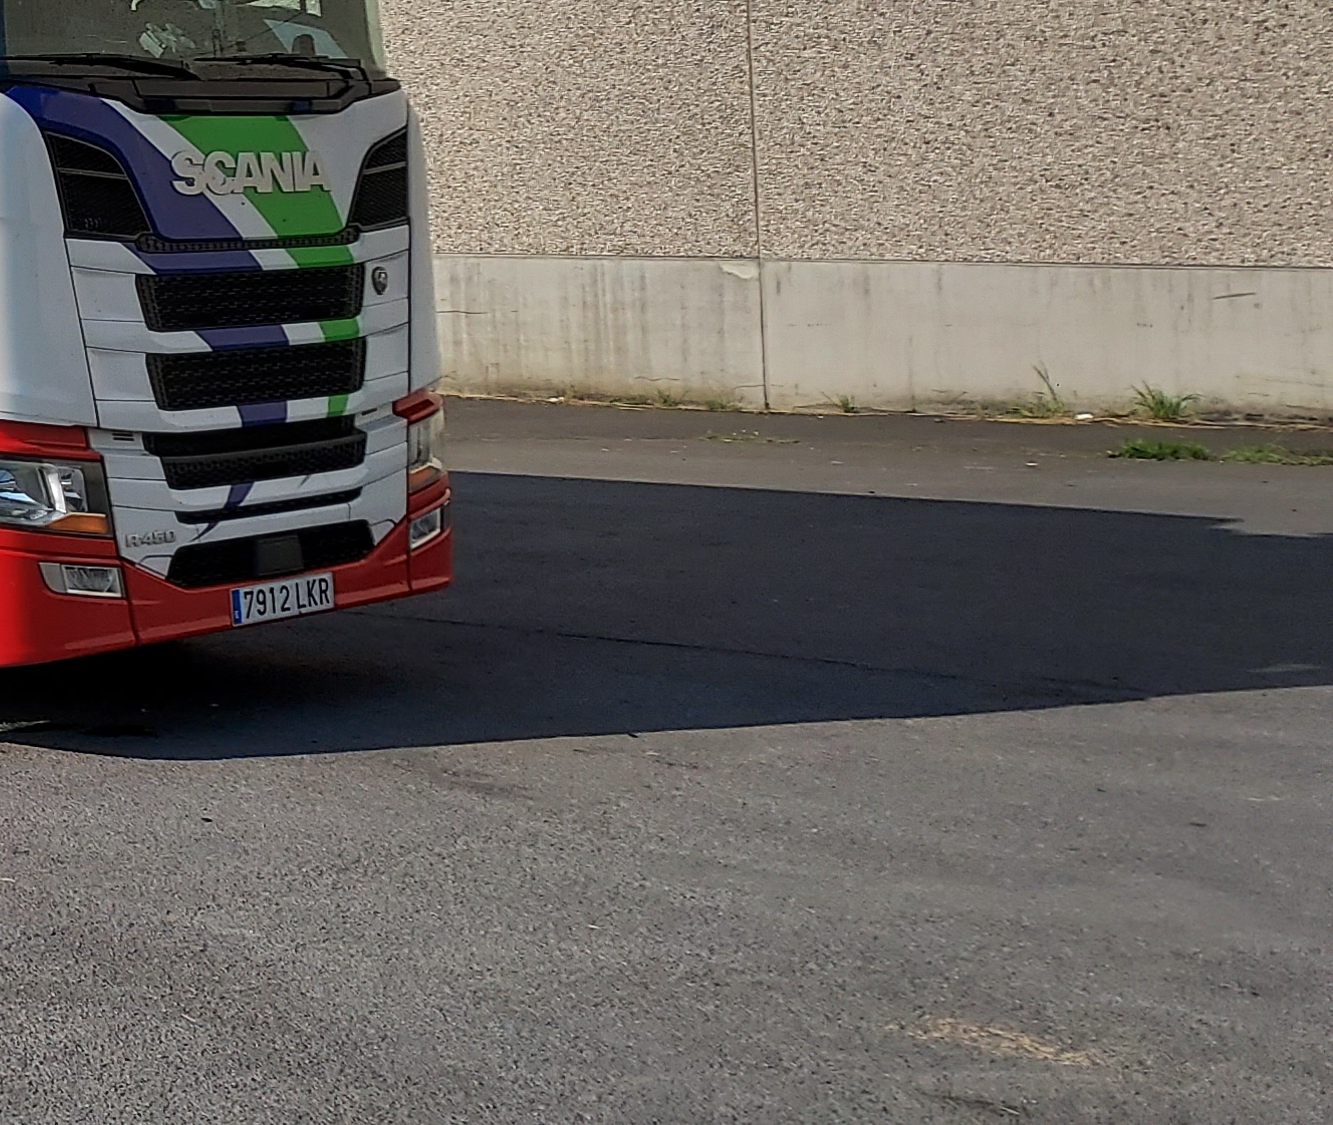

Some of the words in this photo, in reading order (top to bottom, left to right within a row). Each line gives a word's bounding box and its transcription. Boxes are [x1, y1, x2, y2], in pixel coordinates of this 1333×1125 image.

[170, 149, 331, 196] SCANIA
[243, 585, 291, 619] 7912
[295, 578, 330, 609] LKR
